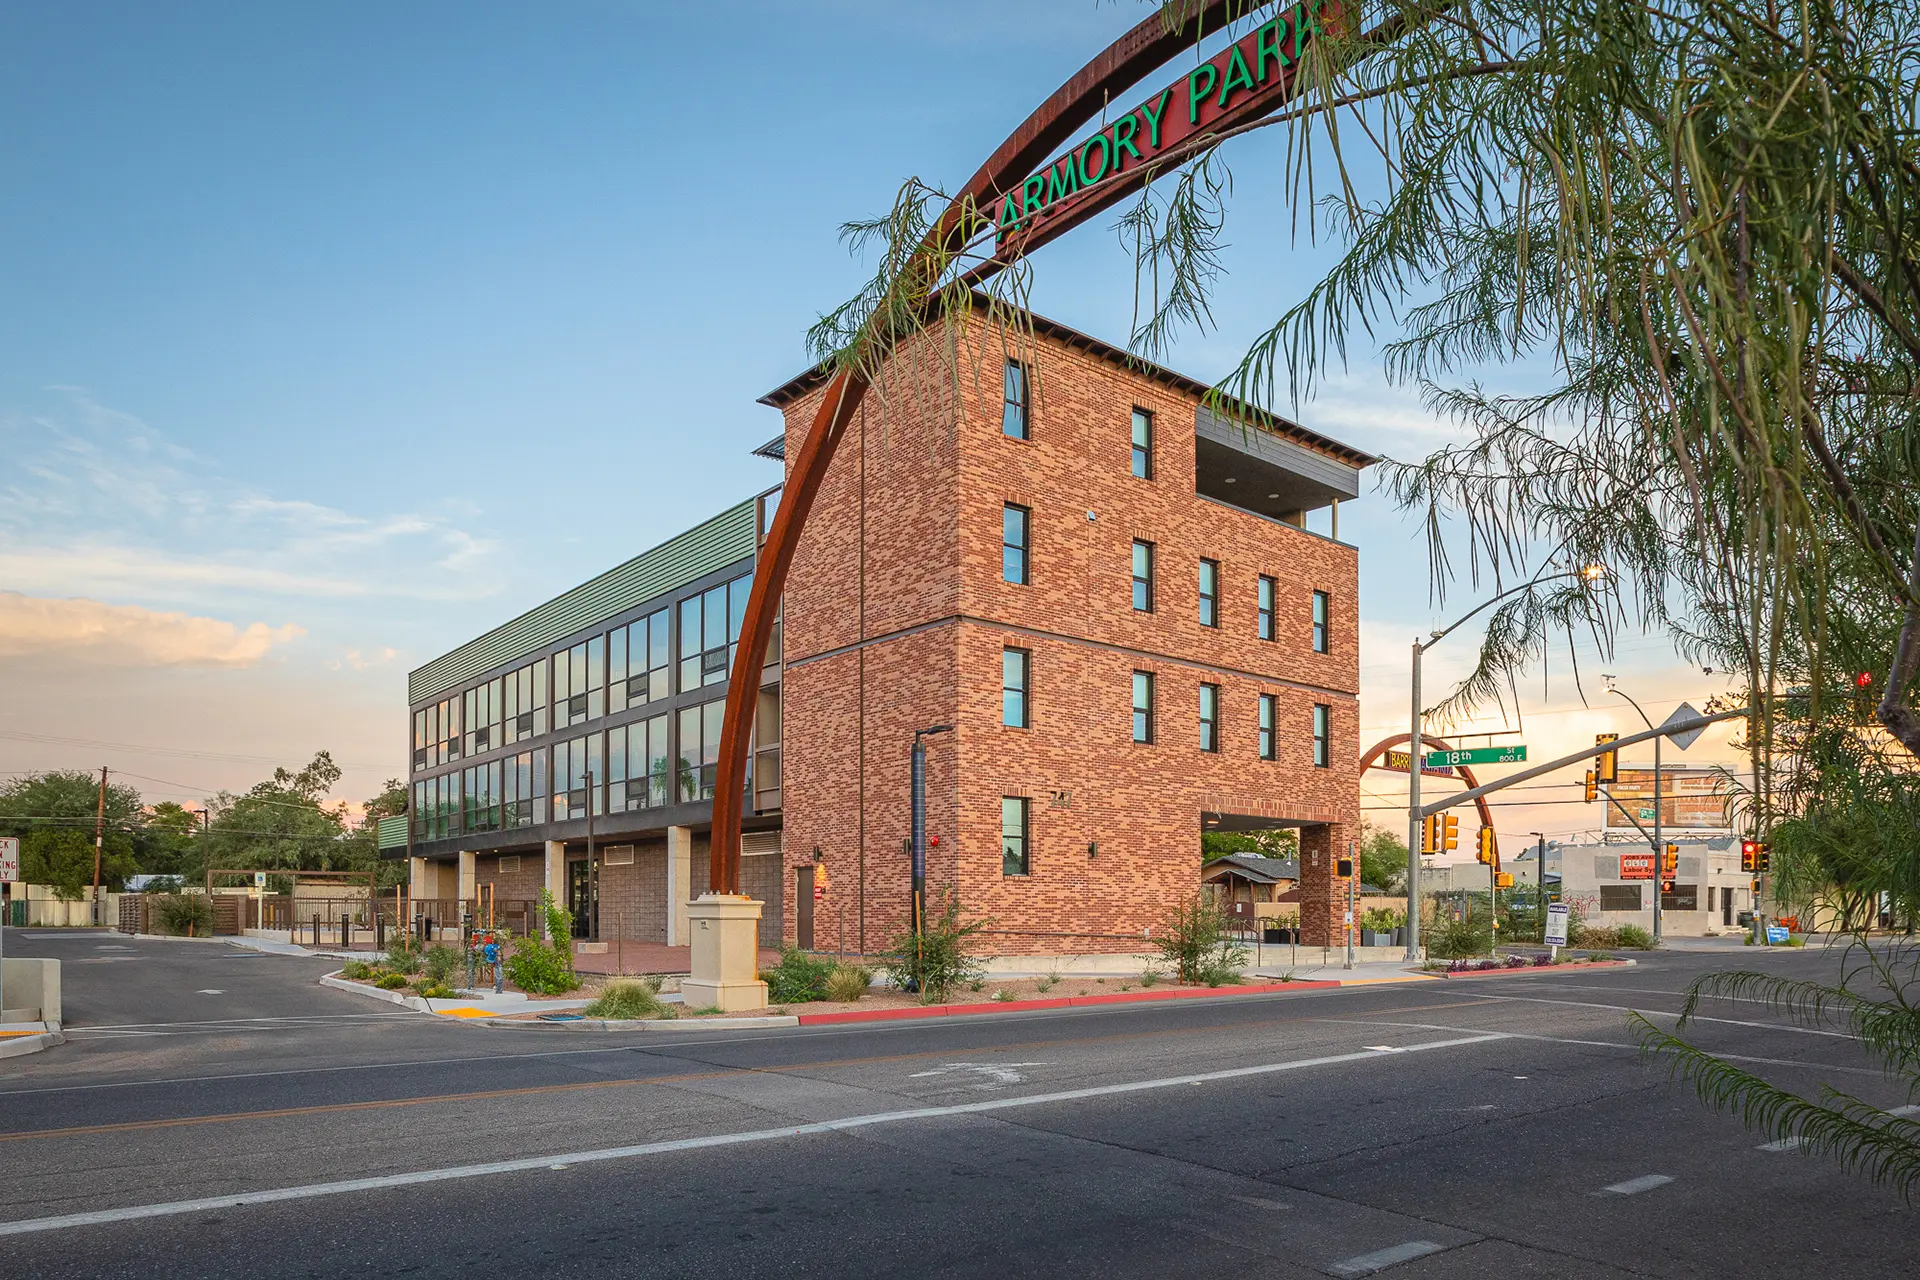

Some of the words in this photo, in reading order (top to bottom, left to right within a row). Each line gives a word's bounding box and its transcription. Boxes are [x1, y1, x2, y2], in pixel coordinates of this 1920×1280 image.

[996, 90, 1173, 242] ARMORY
[1391, 752, 1411, 769] BARRI
[1445, 751, 1472, 765] 18th
[1050, 790, 1072, 809] 747
[0, 841, 9, 849] CK
